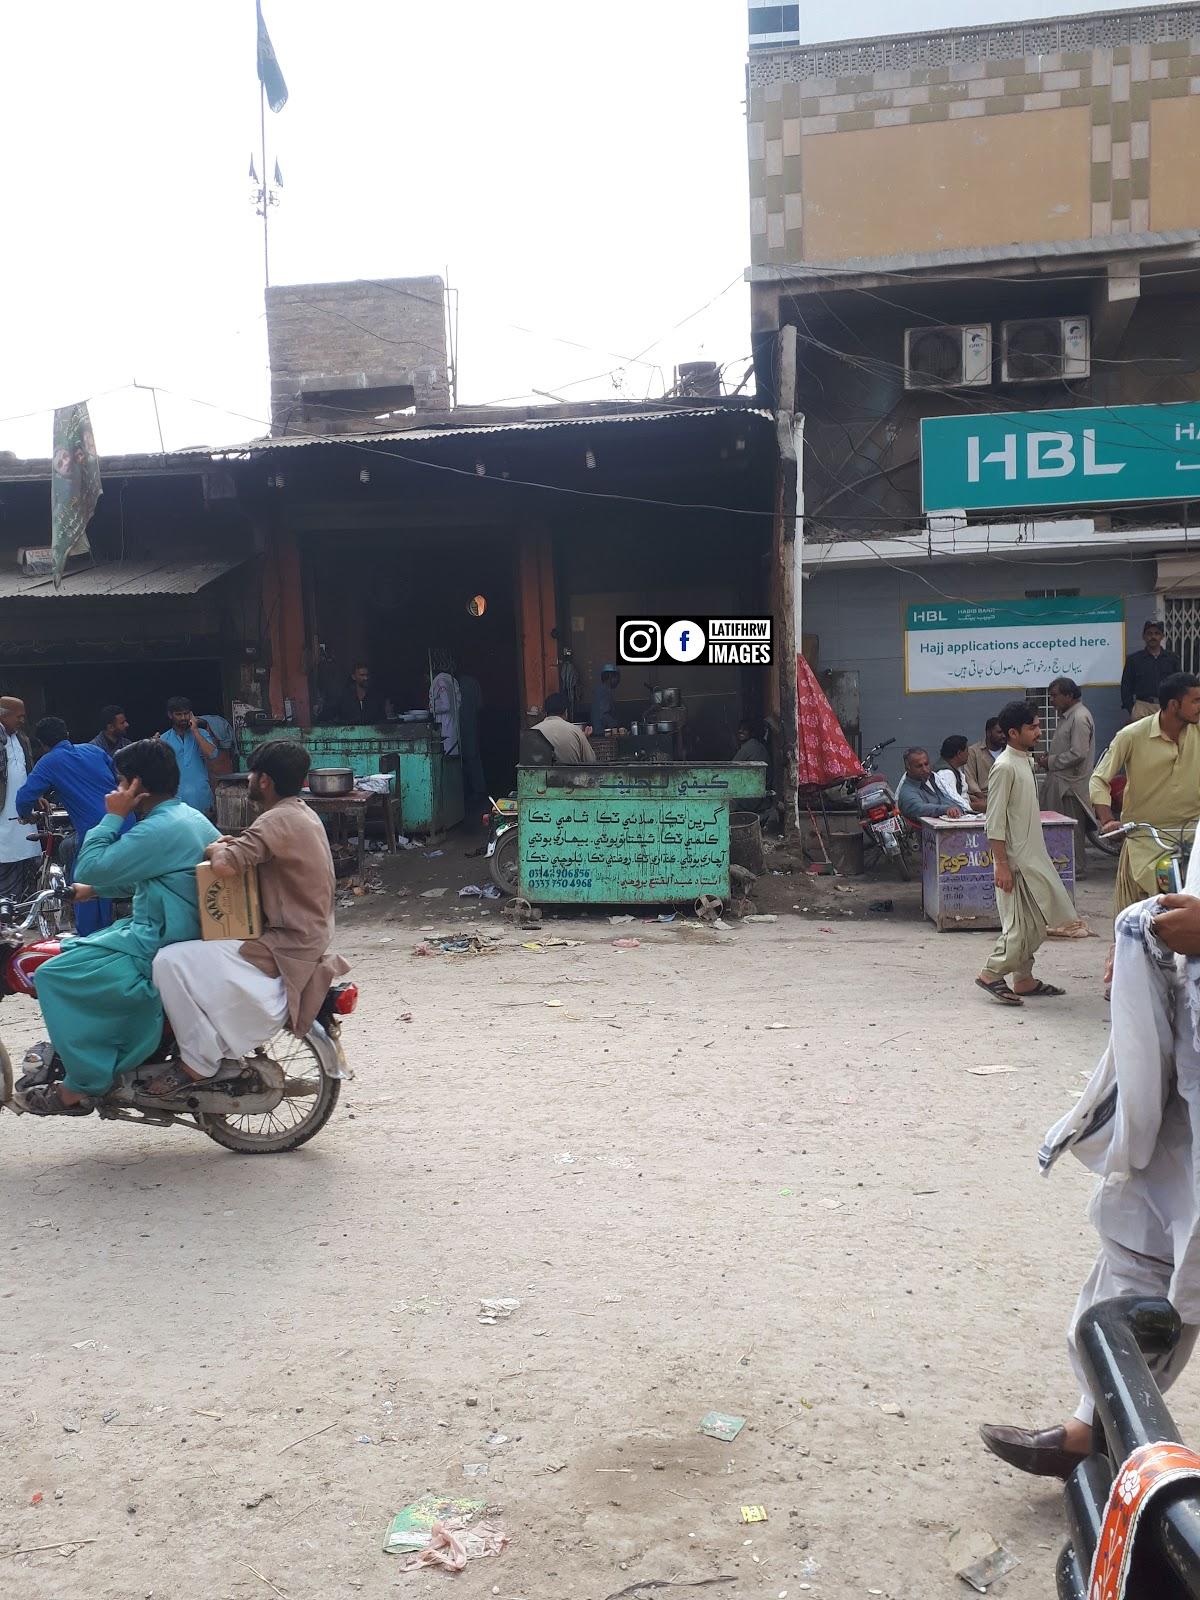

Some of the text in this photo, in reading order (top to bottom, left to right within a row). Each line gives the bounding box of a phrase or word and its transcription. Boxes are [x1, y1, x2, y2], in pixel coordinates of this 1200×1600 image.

[967, 428, 1127, 482] HBL
[913, 610, 948, 622] HBL
[920, 636, 1110, 655] Hajj applications accepted here.
